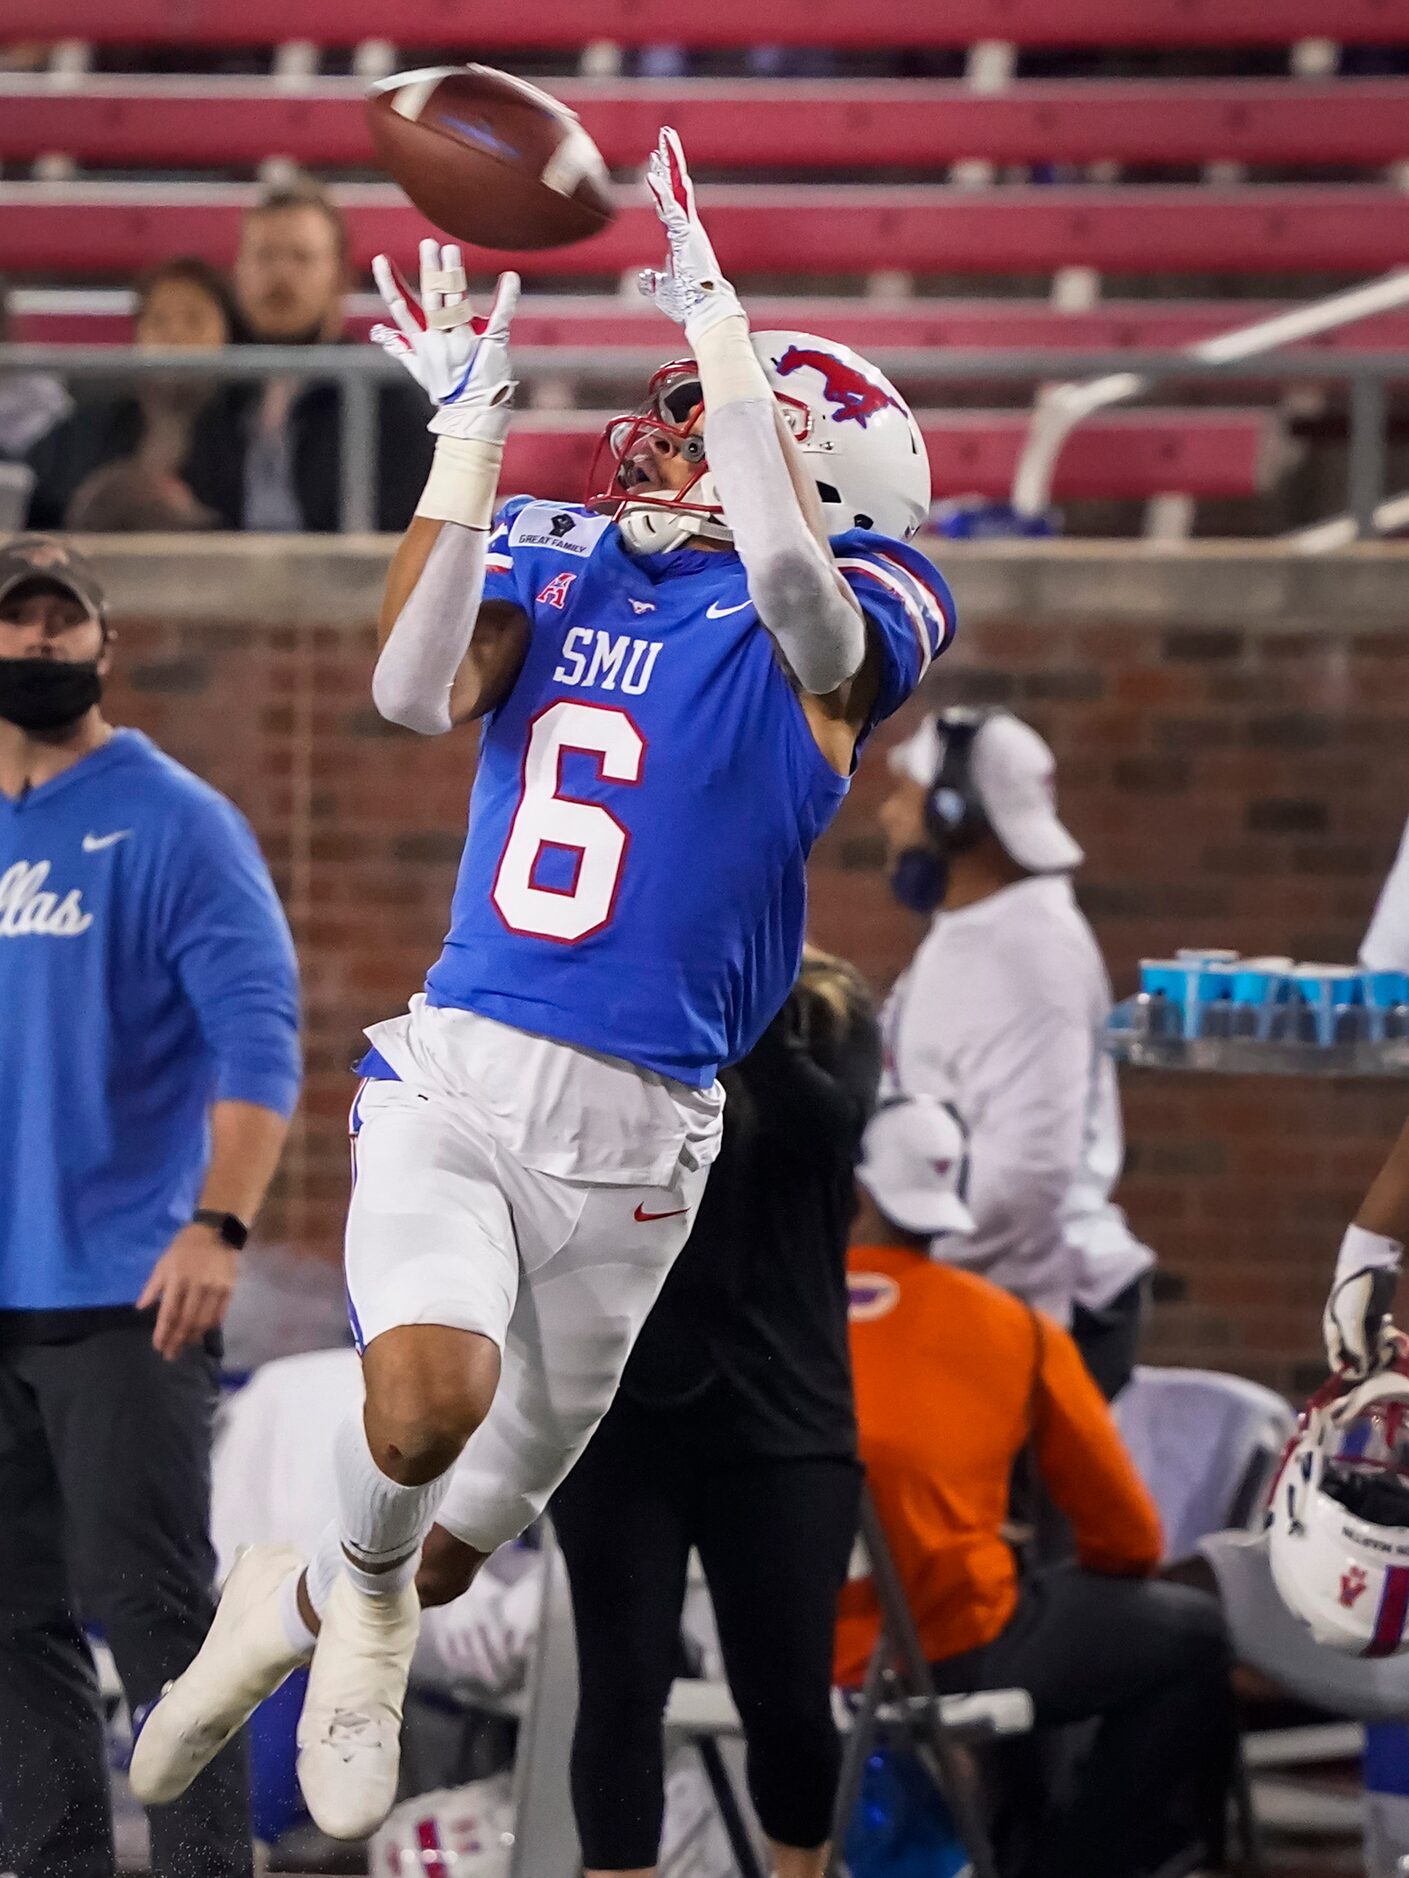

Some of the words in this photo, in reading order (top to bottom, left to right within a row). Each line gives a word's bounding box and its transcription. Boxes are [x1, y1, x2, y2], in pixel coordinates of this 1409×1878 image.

[518, 534, 551, 545] GREAT
[551, 538, 587, 553] FAMILY
[552, 626, 664, 696] SMU
[489, 697, 649, 946] 6
